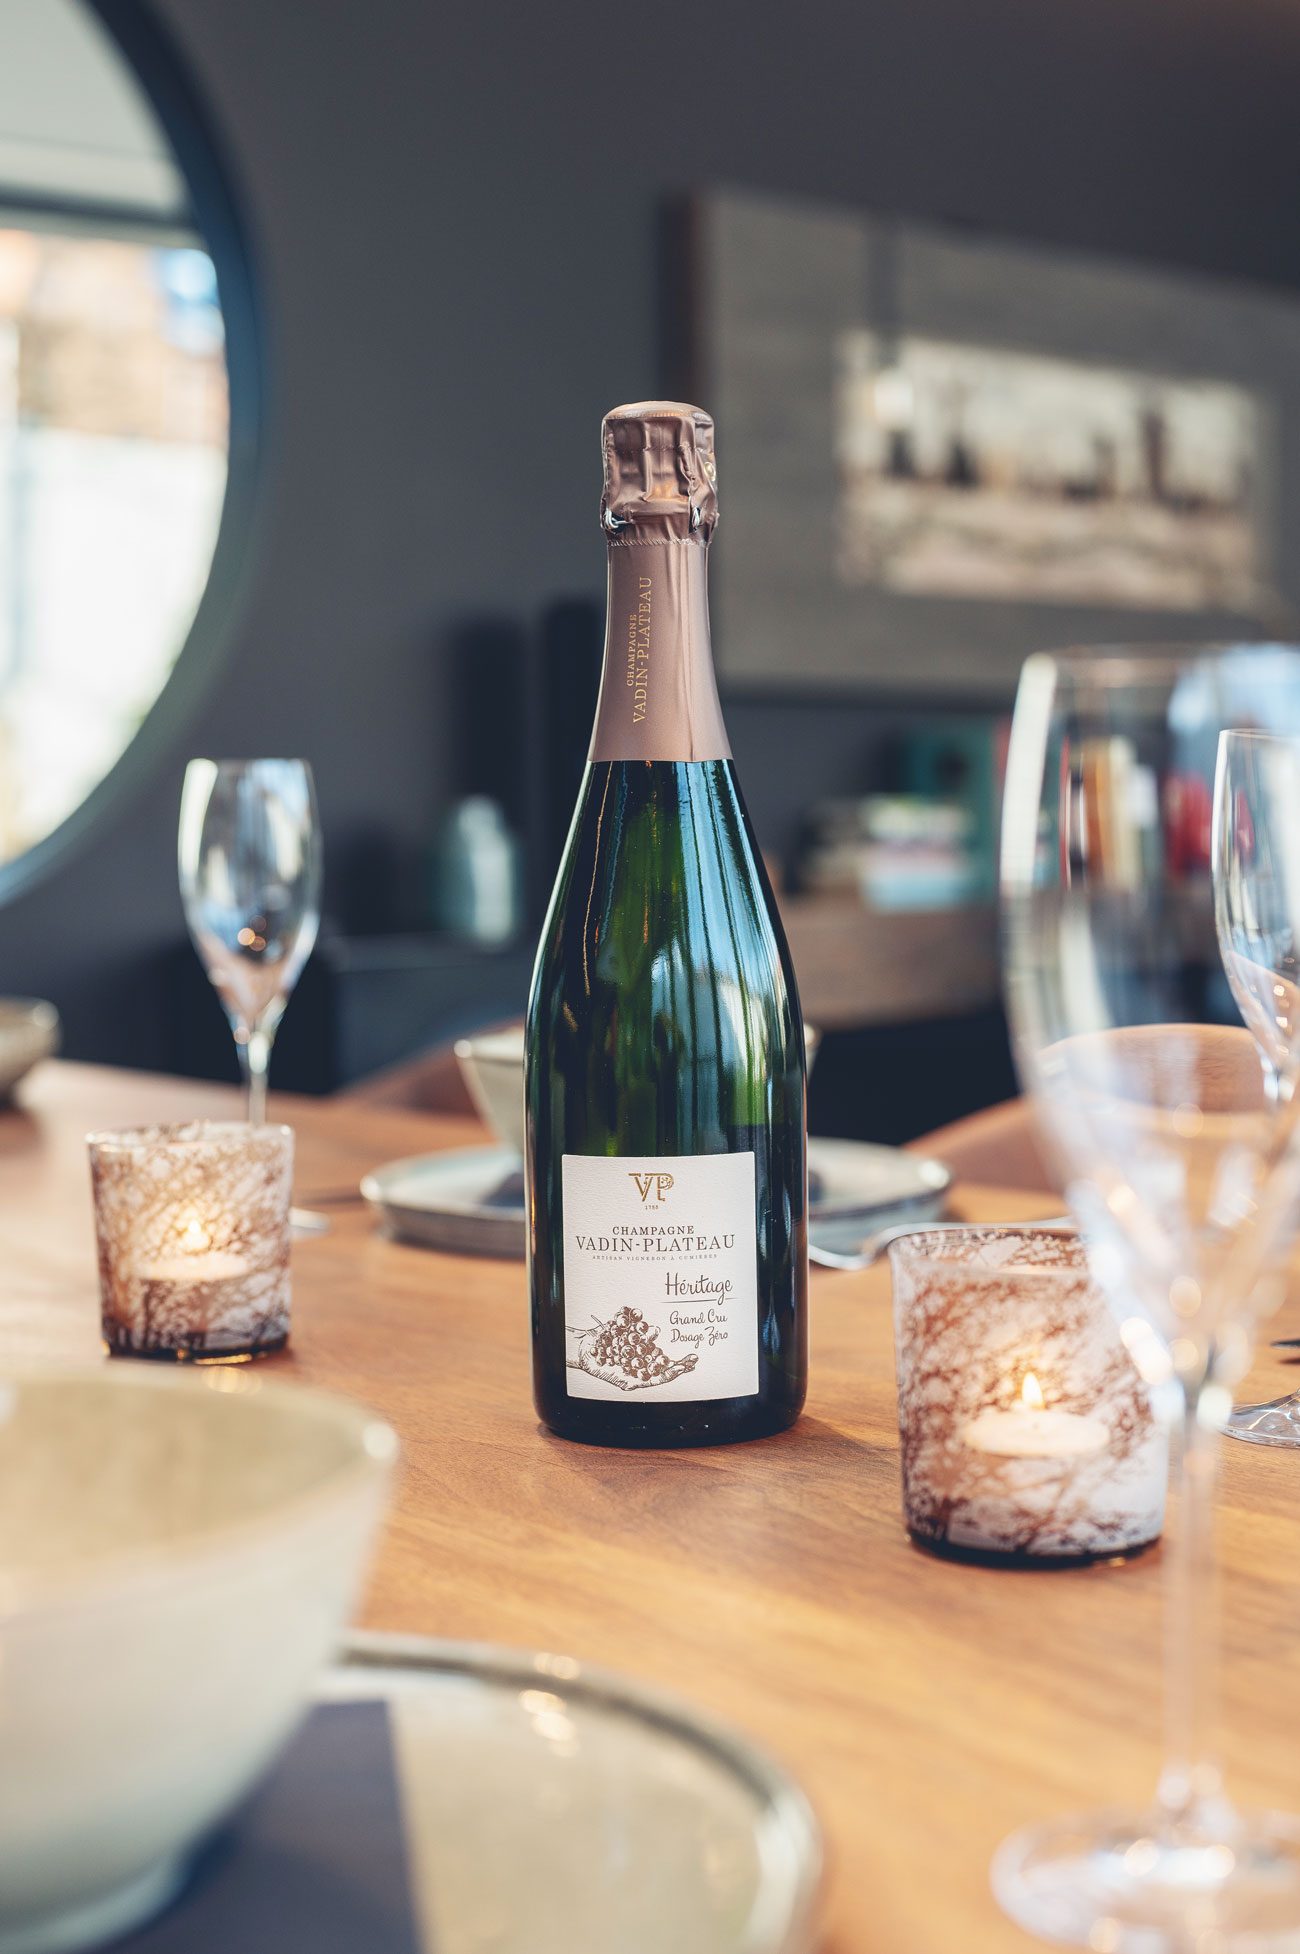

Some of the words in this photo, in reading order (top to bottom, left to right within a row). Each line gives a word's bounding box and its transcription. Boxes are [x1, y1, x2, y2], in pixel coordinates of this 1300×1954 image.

[626, 614, 637, 687] CHAMPAGNE
[632, 576, 652, 723] VADIN-PLATEAU
[628, 1172, 675, 1202] VP
[576, 1234, 736, 1252] VADIN-PLATEAU
[612, 1226, 694, 1235] CHAMPAGNE
[665, 1272, 733, 1305] Héritage
[669, 1310, 705, 1325] Grand
[707, 1308, 728, 1323] Cru
[670, 1328, 705, 1349] Dosage
[704, 1325, 729, 1346] Zéro
